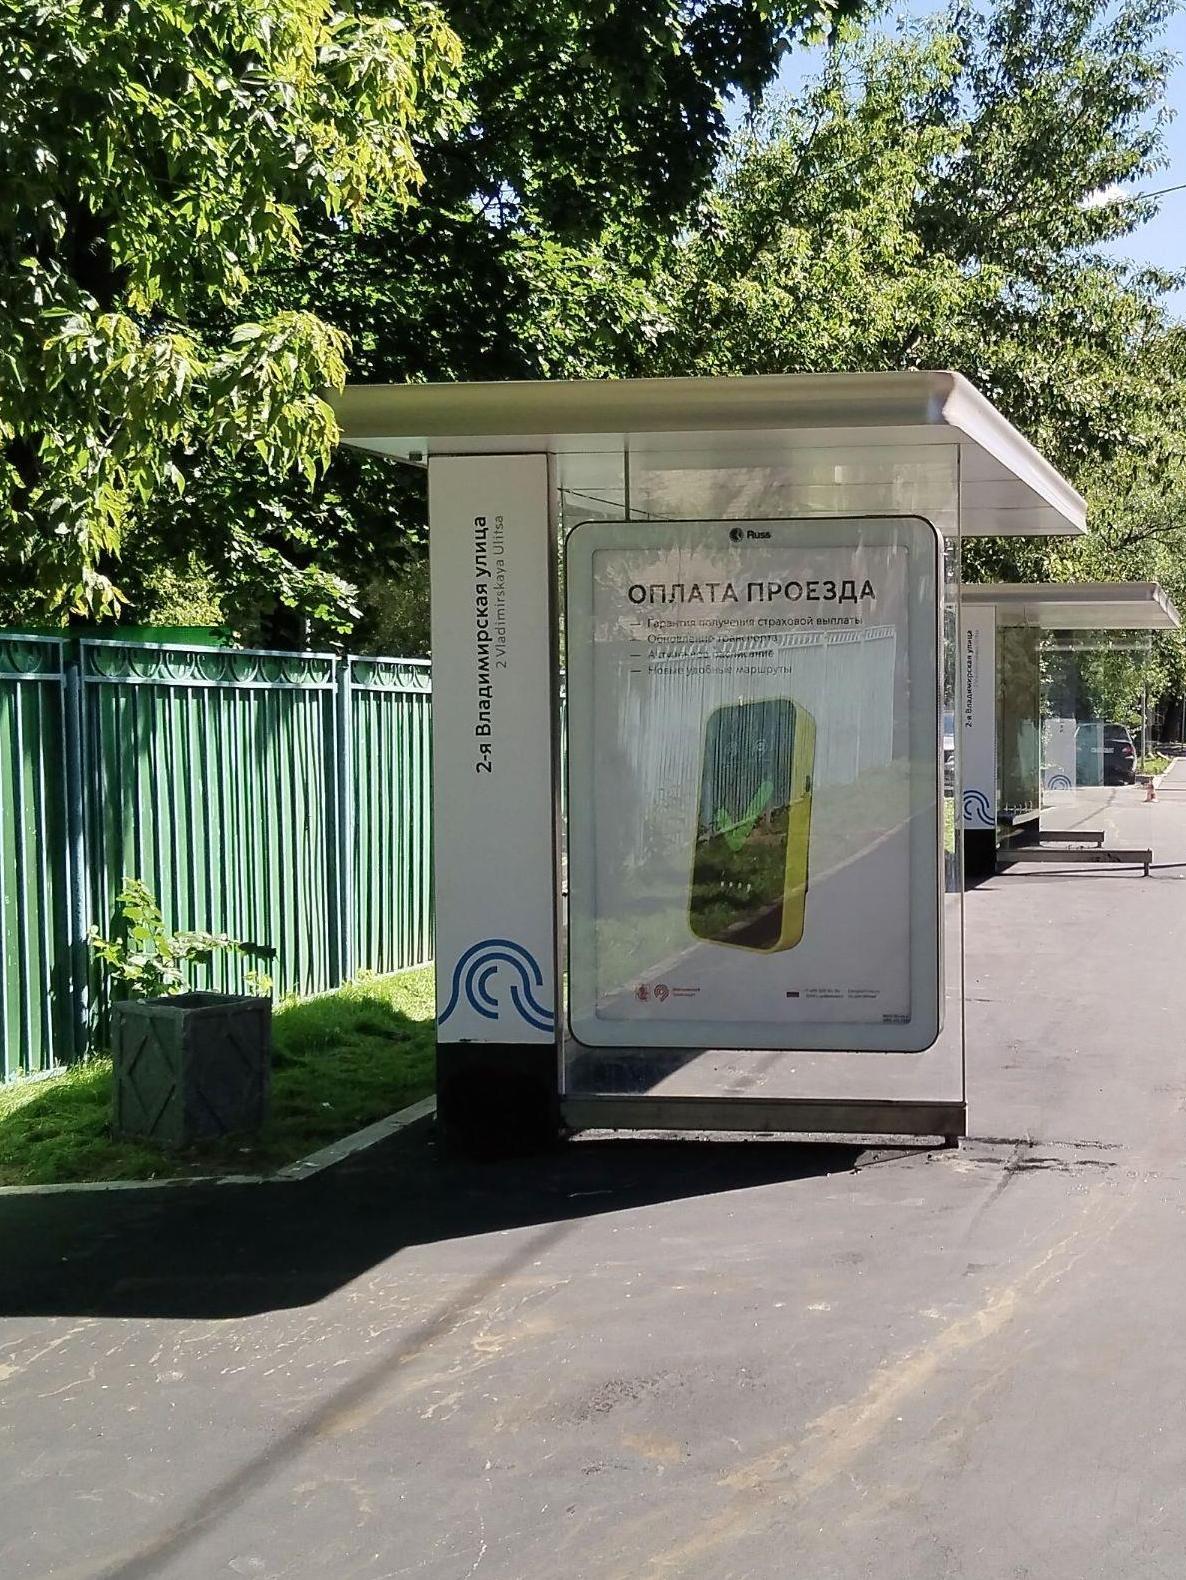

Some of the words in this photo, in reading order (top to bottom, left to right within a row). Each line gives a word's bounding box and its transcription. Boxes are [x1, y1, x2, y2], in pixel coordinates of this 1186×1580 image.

[474, 516, 492, 578] улица
[493, 515, 505, 555] Ulitsa
[746, 529, 771, 540] Russ
[628, 582, 739, 605] ОПЛАТА
[747, 580, 876, 605] ПРОЕЗДА
[494, 559, 507, 659] Vladimirskaya
[647, 618, 696, 630] Гарантия
[700, 618, 755, 630] получения
[758, 616, 814, 628] страховой
[816, 616, 863, 626] выплаты
[475, 583, 492, 737] Владимирская
[496, 660, 507, 669] 2
[735, 664, 792, 676] маршруты
[965, 655, 973, 714] Владимирская
[475, 743, 492, 774] 2-я
